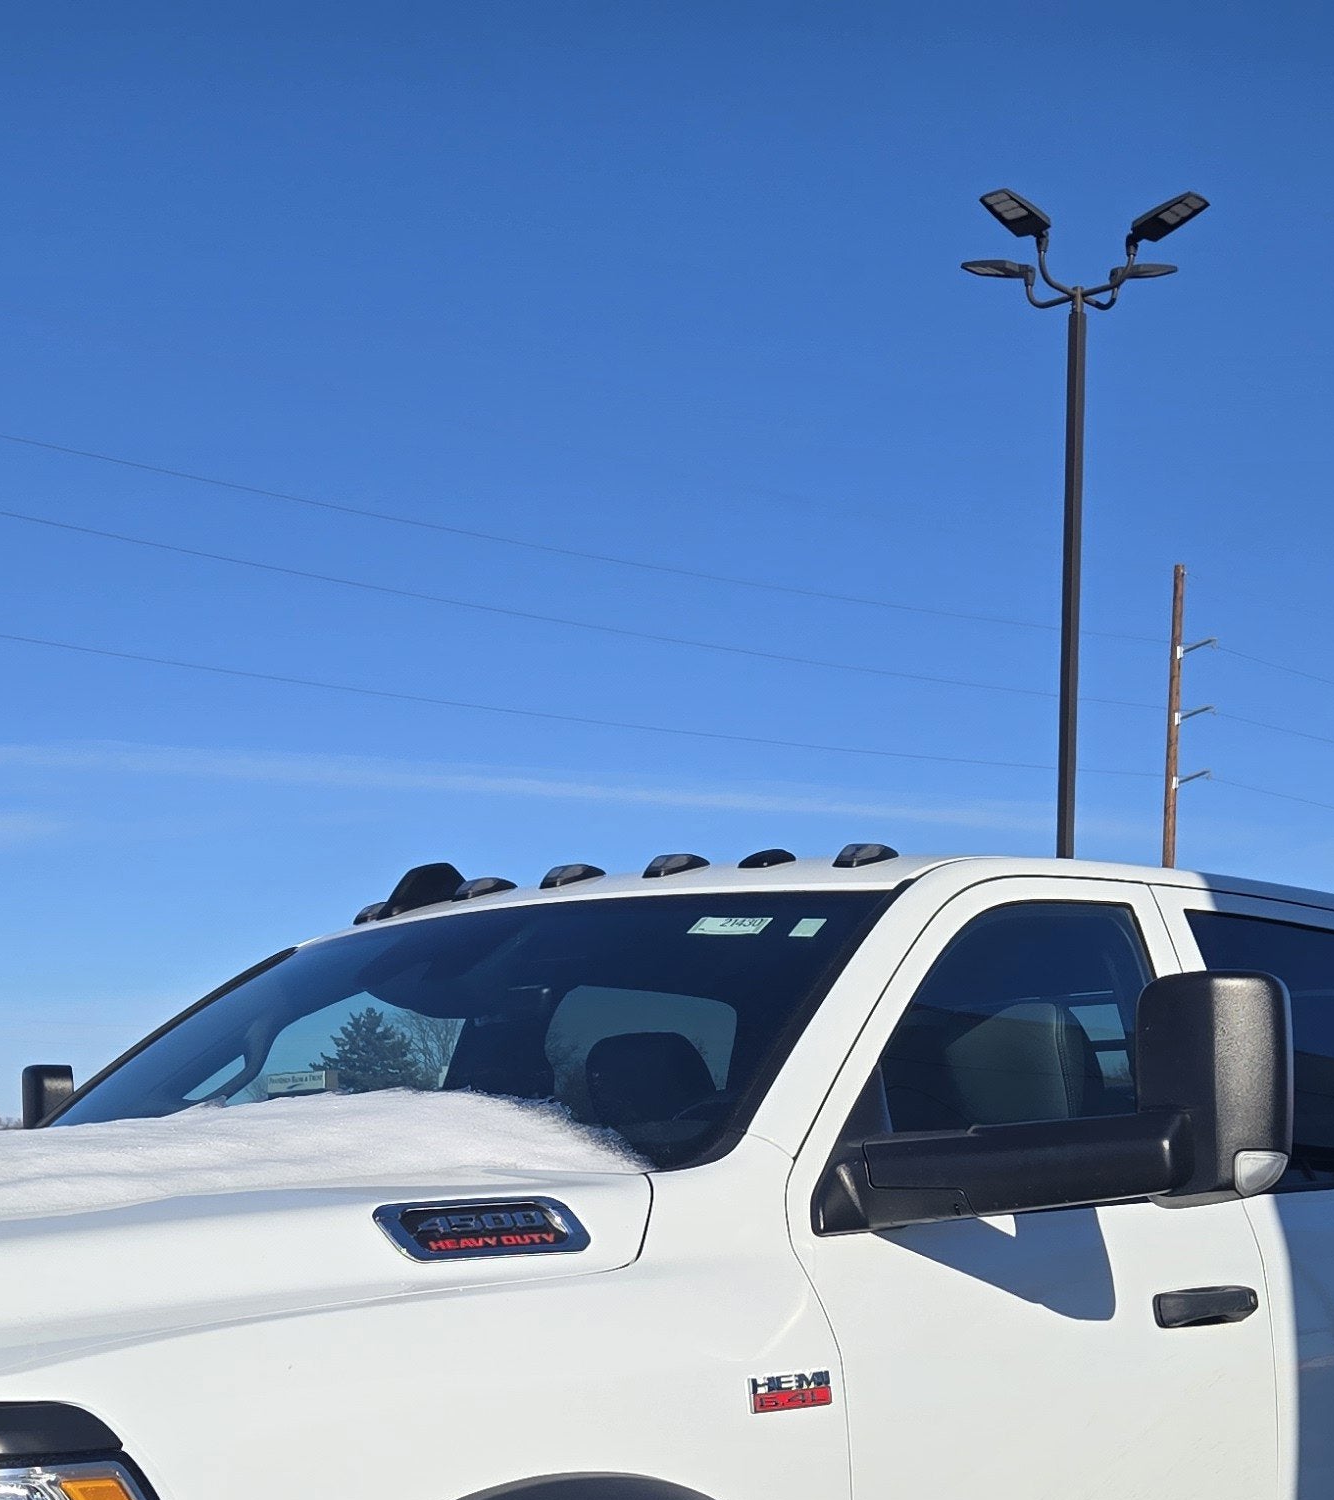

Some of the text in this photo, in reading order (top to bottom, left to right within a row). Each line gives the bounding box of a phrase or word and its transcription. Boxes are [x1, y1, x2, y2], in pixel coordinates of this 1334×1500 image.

[418, 1210, 547, 1235] 4500
[429, 1232, 556, 1252] HEAVY DUTY
[748, 1370, 830, 1394] HEMI
